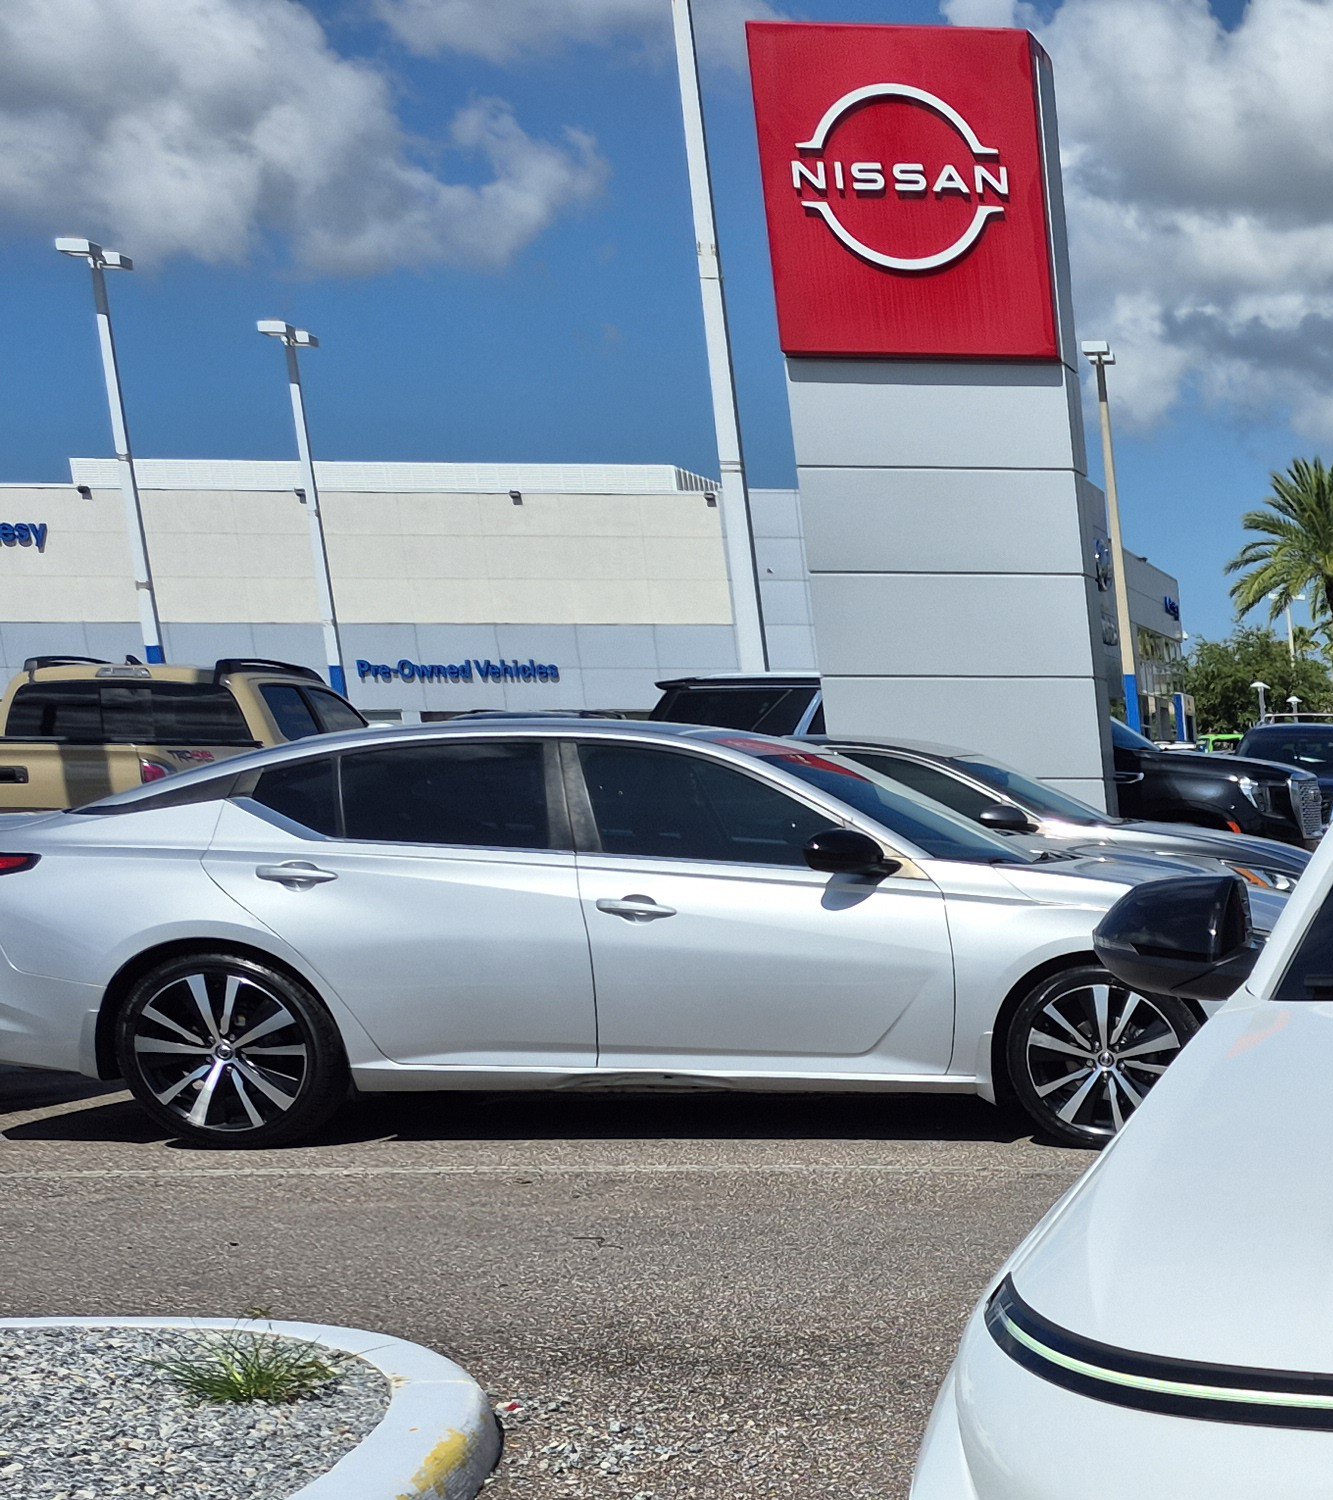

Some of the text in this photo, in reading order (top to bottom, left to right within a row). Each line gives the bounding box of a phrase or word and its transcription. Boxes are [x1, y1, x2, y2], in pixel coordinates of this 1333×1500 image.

[790, 160, 1010, 196] NISSAN
[356, 658, 560, 683] Pre-Owned Vehicles
